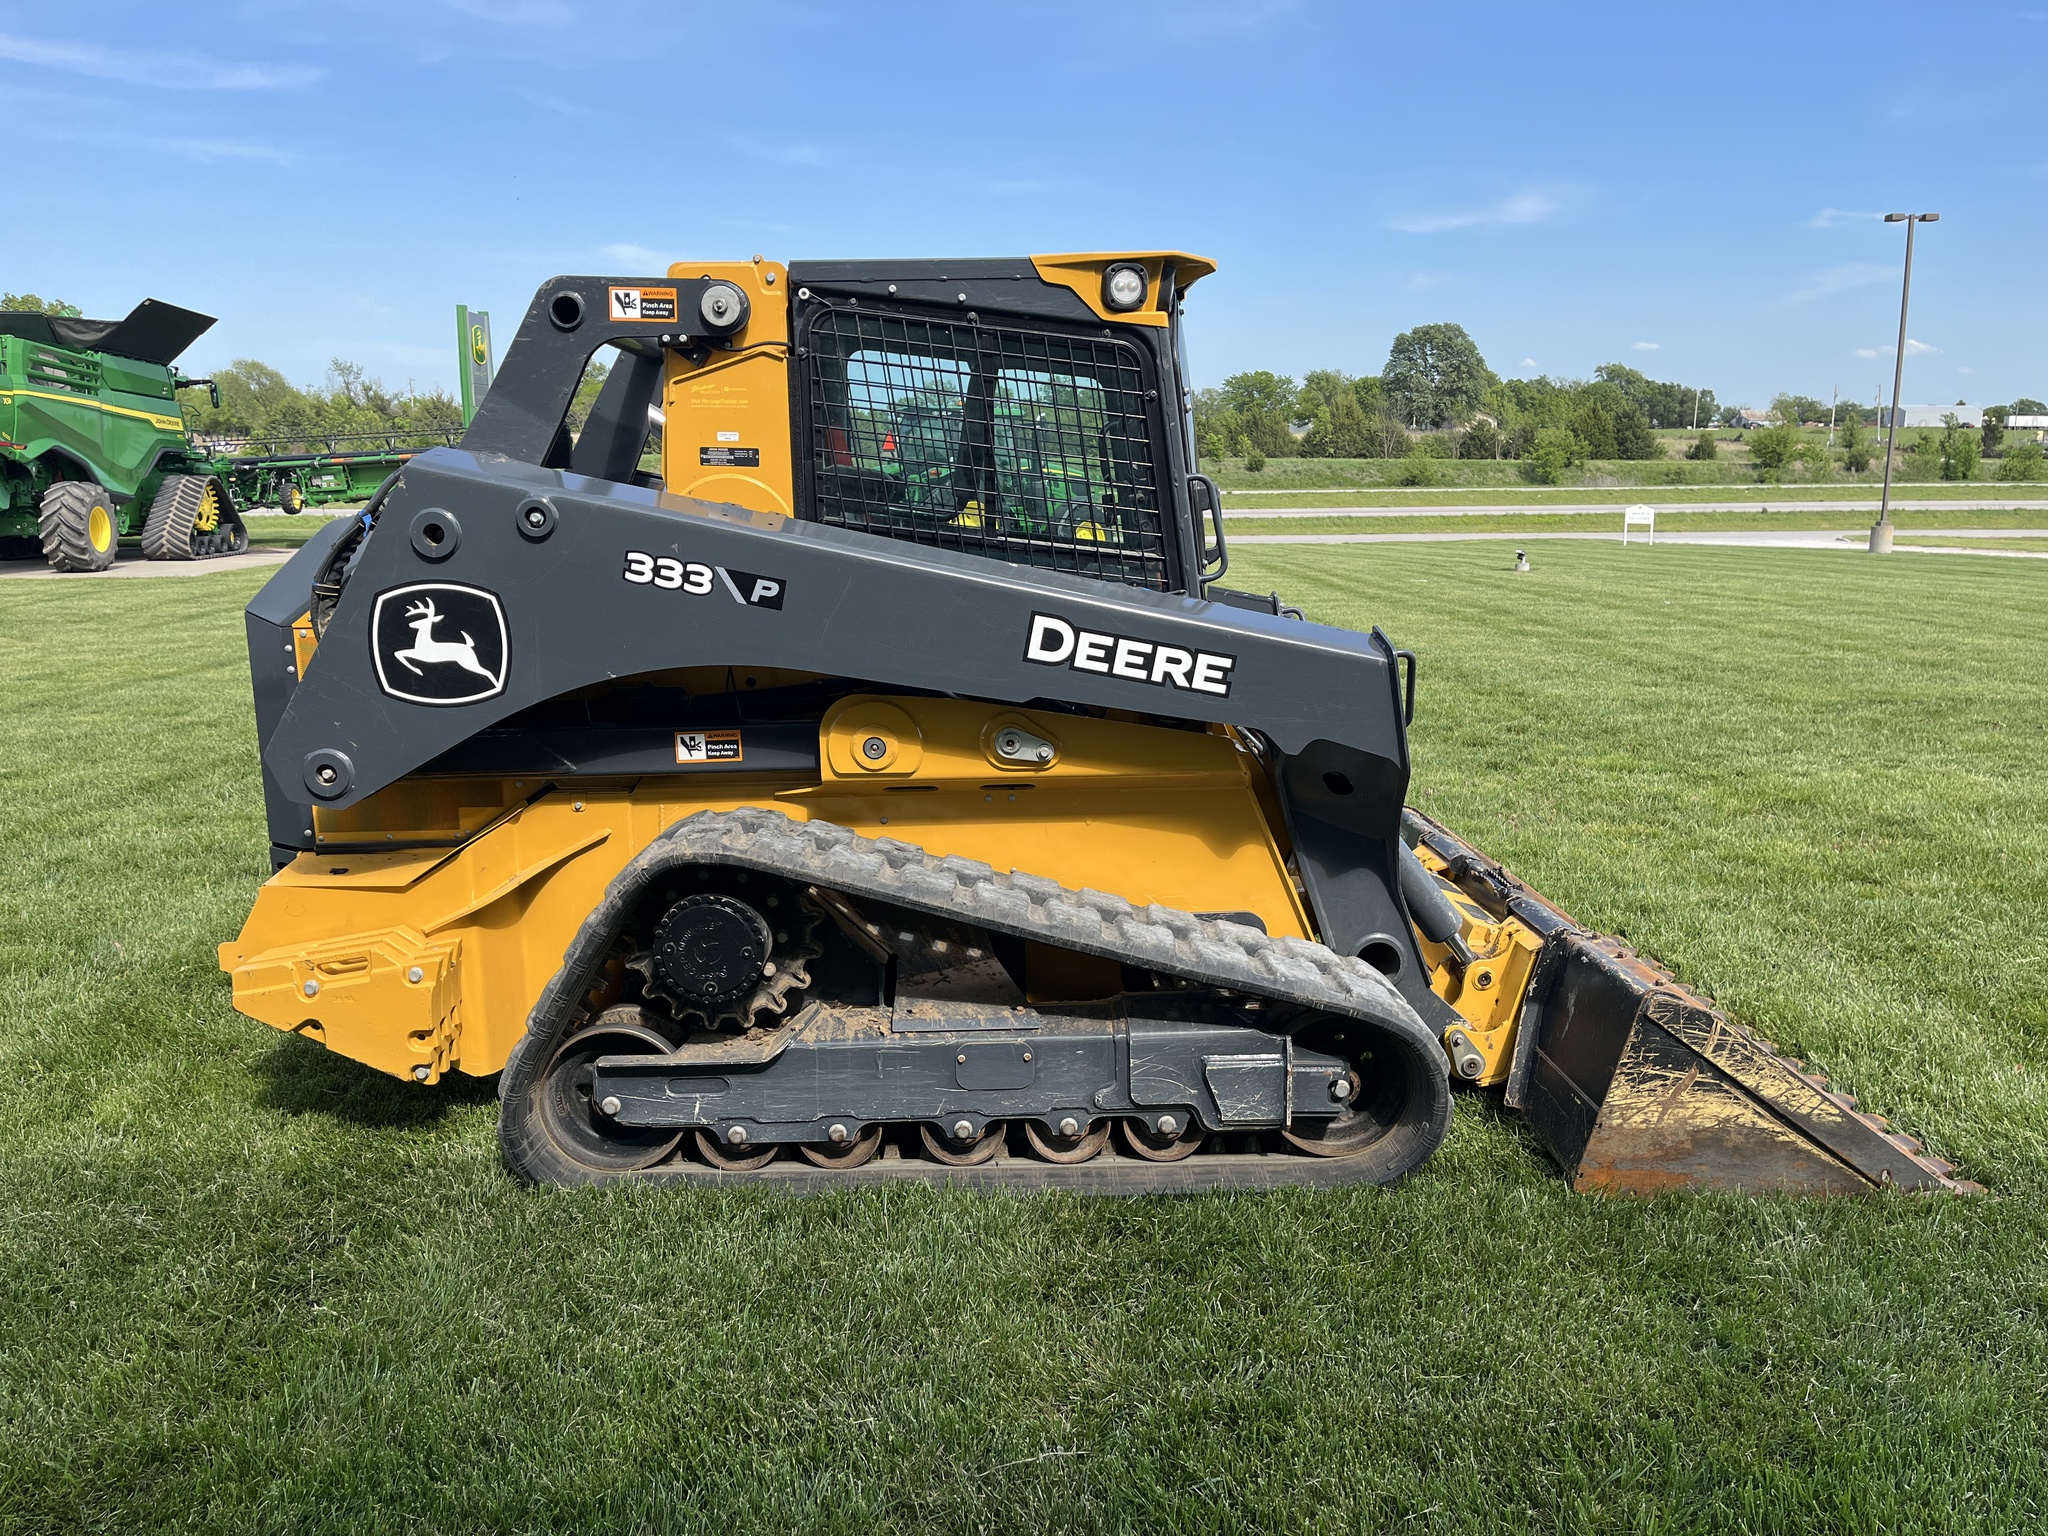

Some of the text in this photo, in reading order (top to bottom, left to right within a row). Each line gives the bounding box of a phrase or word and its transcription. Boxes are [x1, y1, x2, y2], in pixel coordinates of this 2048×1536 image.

[2, 397, 12, 405] X9
[624, 552, 780, 602] 333 P
[1027, 614, 1233, 695] DEERE
